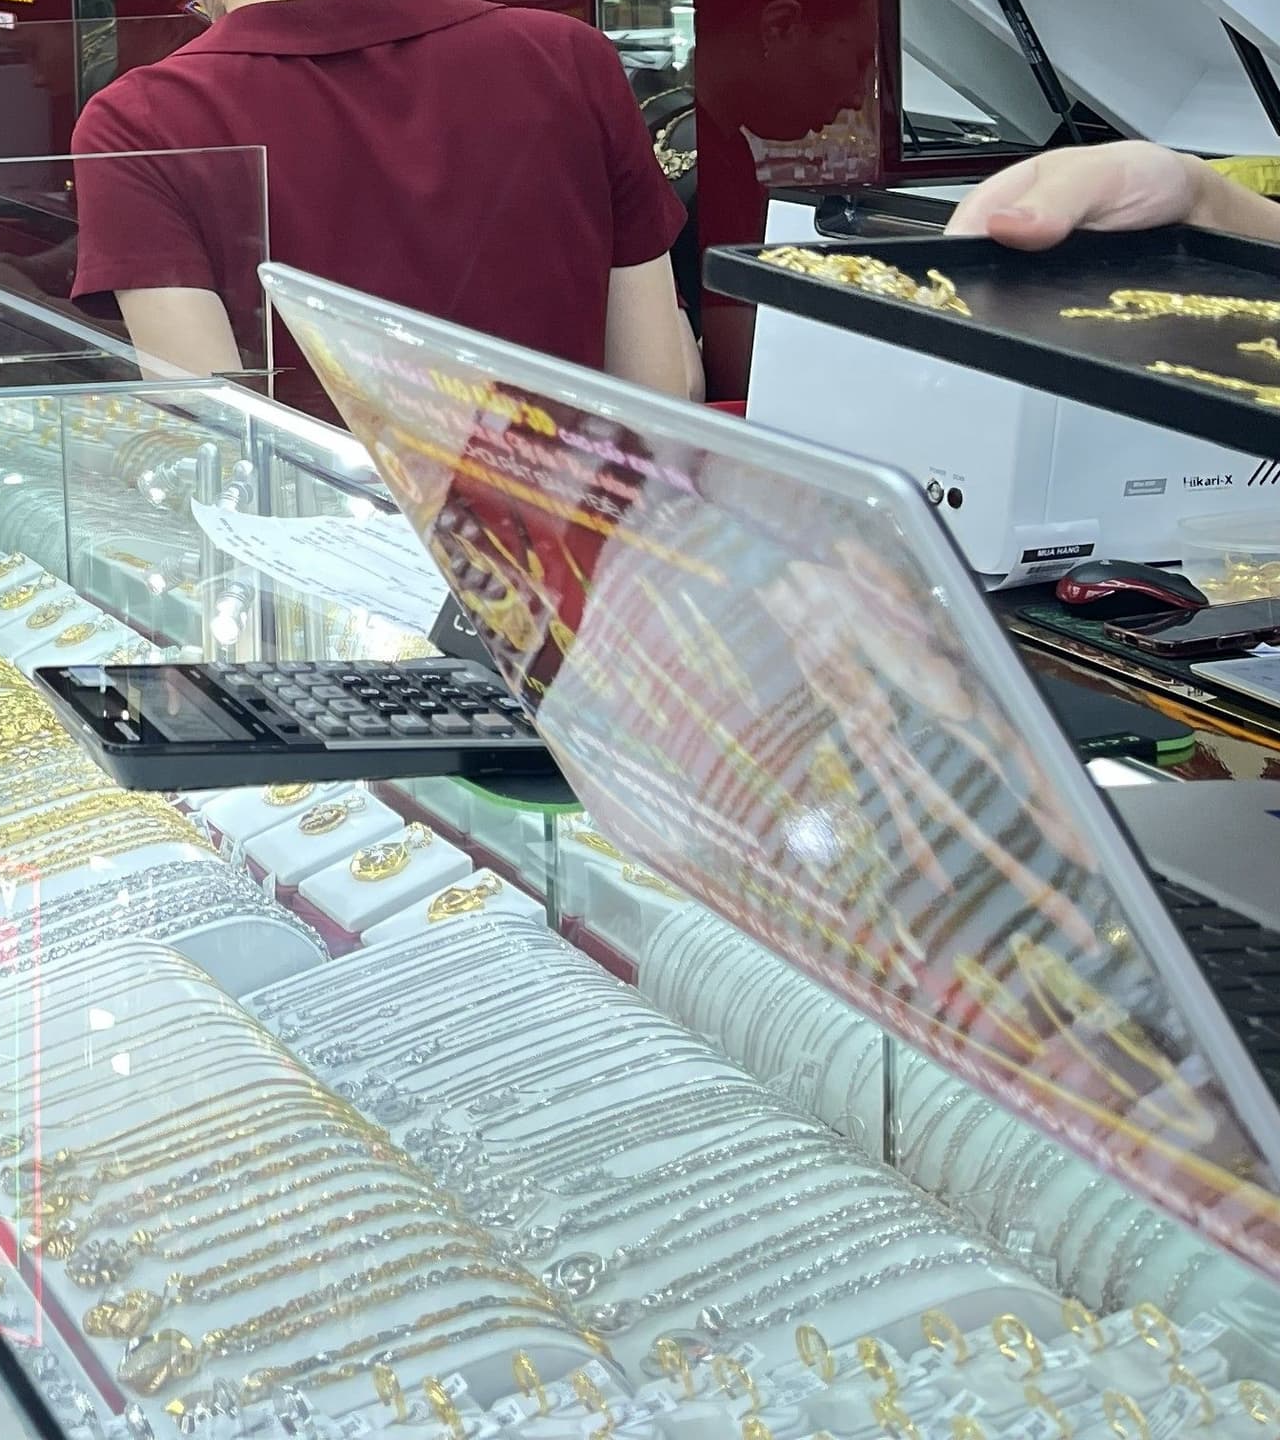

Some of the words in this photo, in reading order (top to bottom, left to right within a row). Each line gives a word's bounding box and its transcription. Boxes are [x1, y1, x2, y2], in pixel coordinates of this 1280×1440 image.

[1183, 474, 1234, 488] Hikari-X
[1037, 546, 1055, 557] MUA
[1056, 544, 1081, 556] HÀNG
